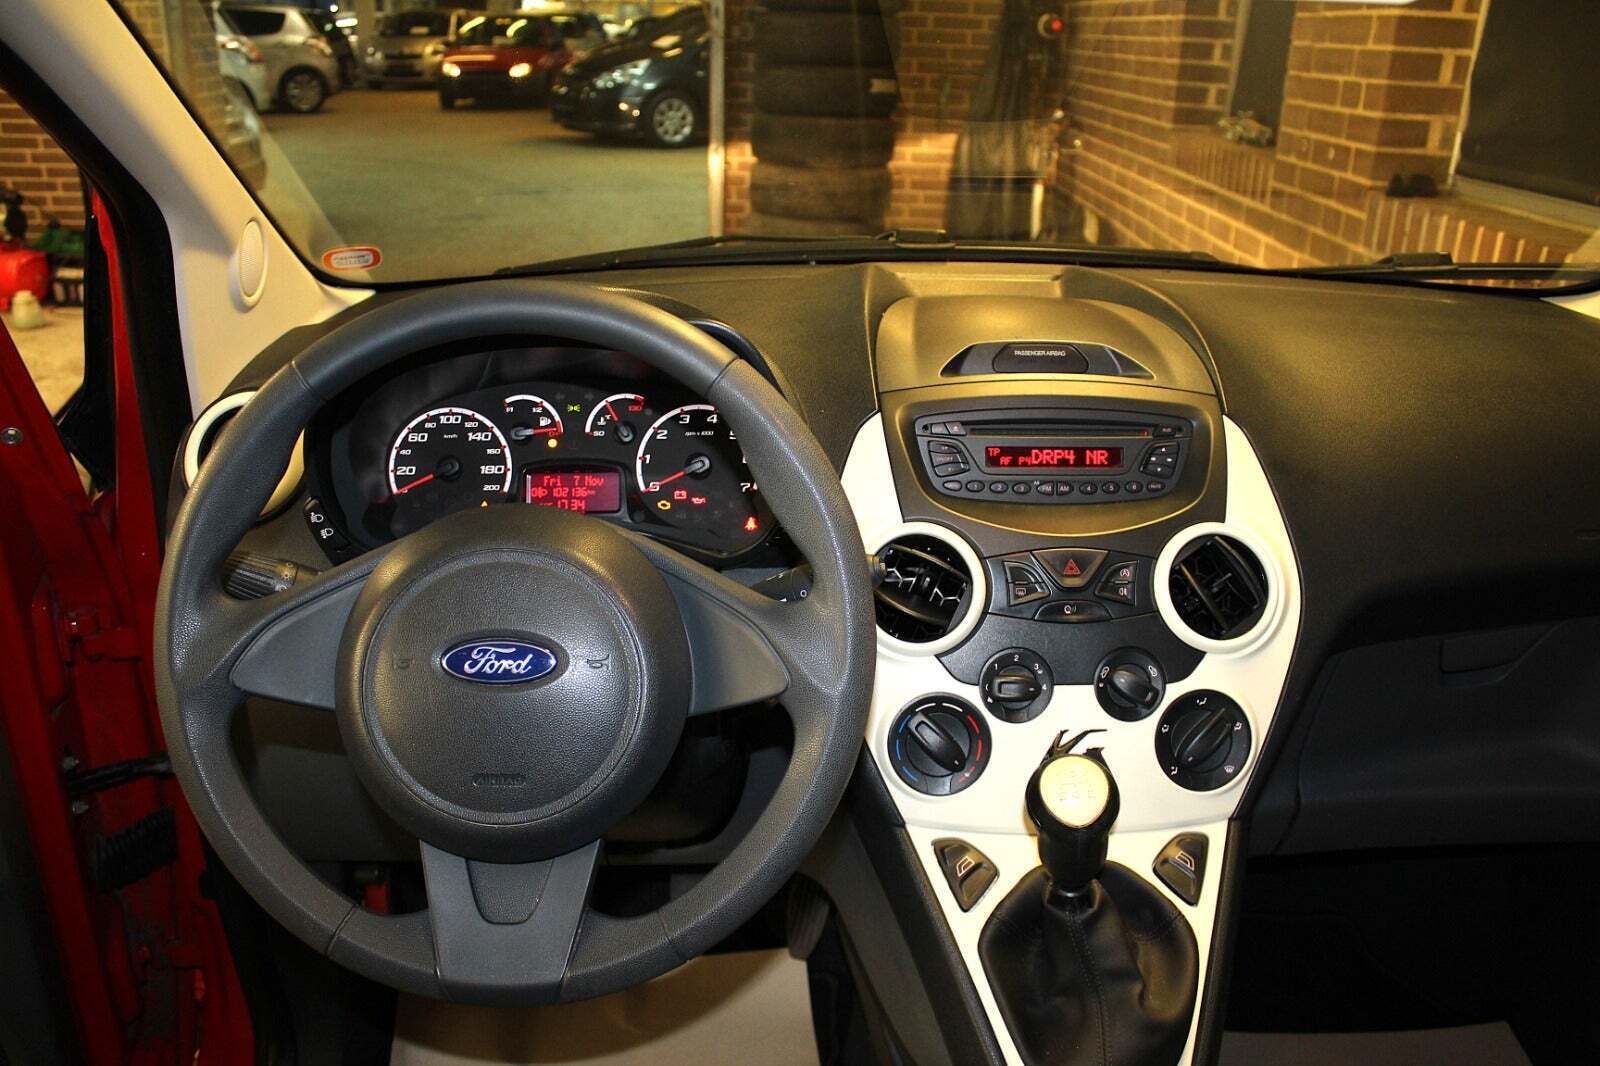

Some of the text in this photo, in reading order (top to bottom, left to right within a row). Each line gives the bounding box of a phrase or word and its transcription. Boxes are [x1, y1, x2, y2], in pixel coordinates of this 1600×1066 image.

[439, 415, 462, 424] 100
[679, 414, 690, 424] 3
[706, 414, 718, 424] 4
[408, 432, 428, 442] 60
[467, 432, 492, 441] 140
[656, 429, 668, 440] 2
[988, 447, 1000, 456] TP
[645, 454, 651, 464] 1
[1000, 457, 1013, 465] AF
[1031, 449, 1076, 465] DRP4
[1086, 449, 1109, 465] NR
[396, 466, 416, 475] 20
[479, 465, 504, 474] 180
[543, 475, 604, 486] Fri 7 Nov
[740, 482, 751, 492] 7
[463, 646, 534, 675] Ford
